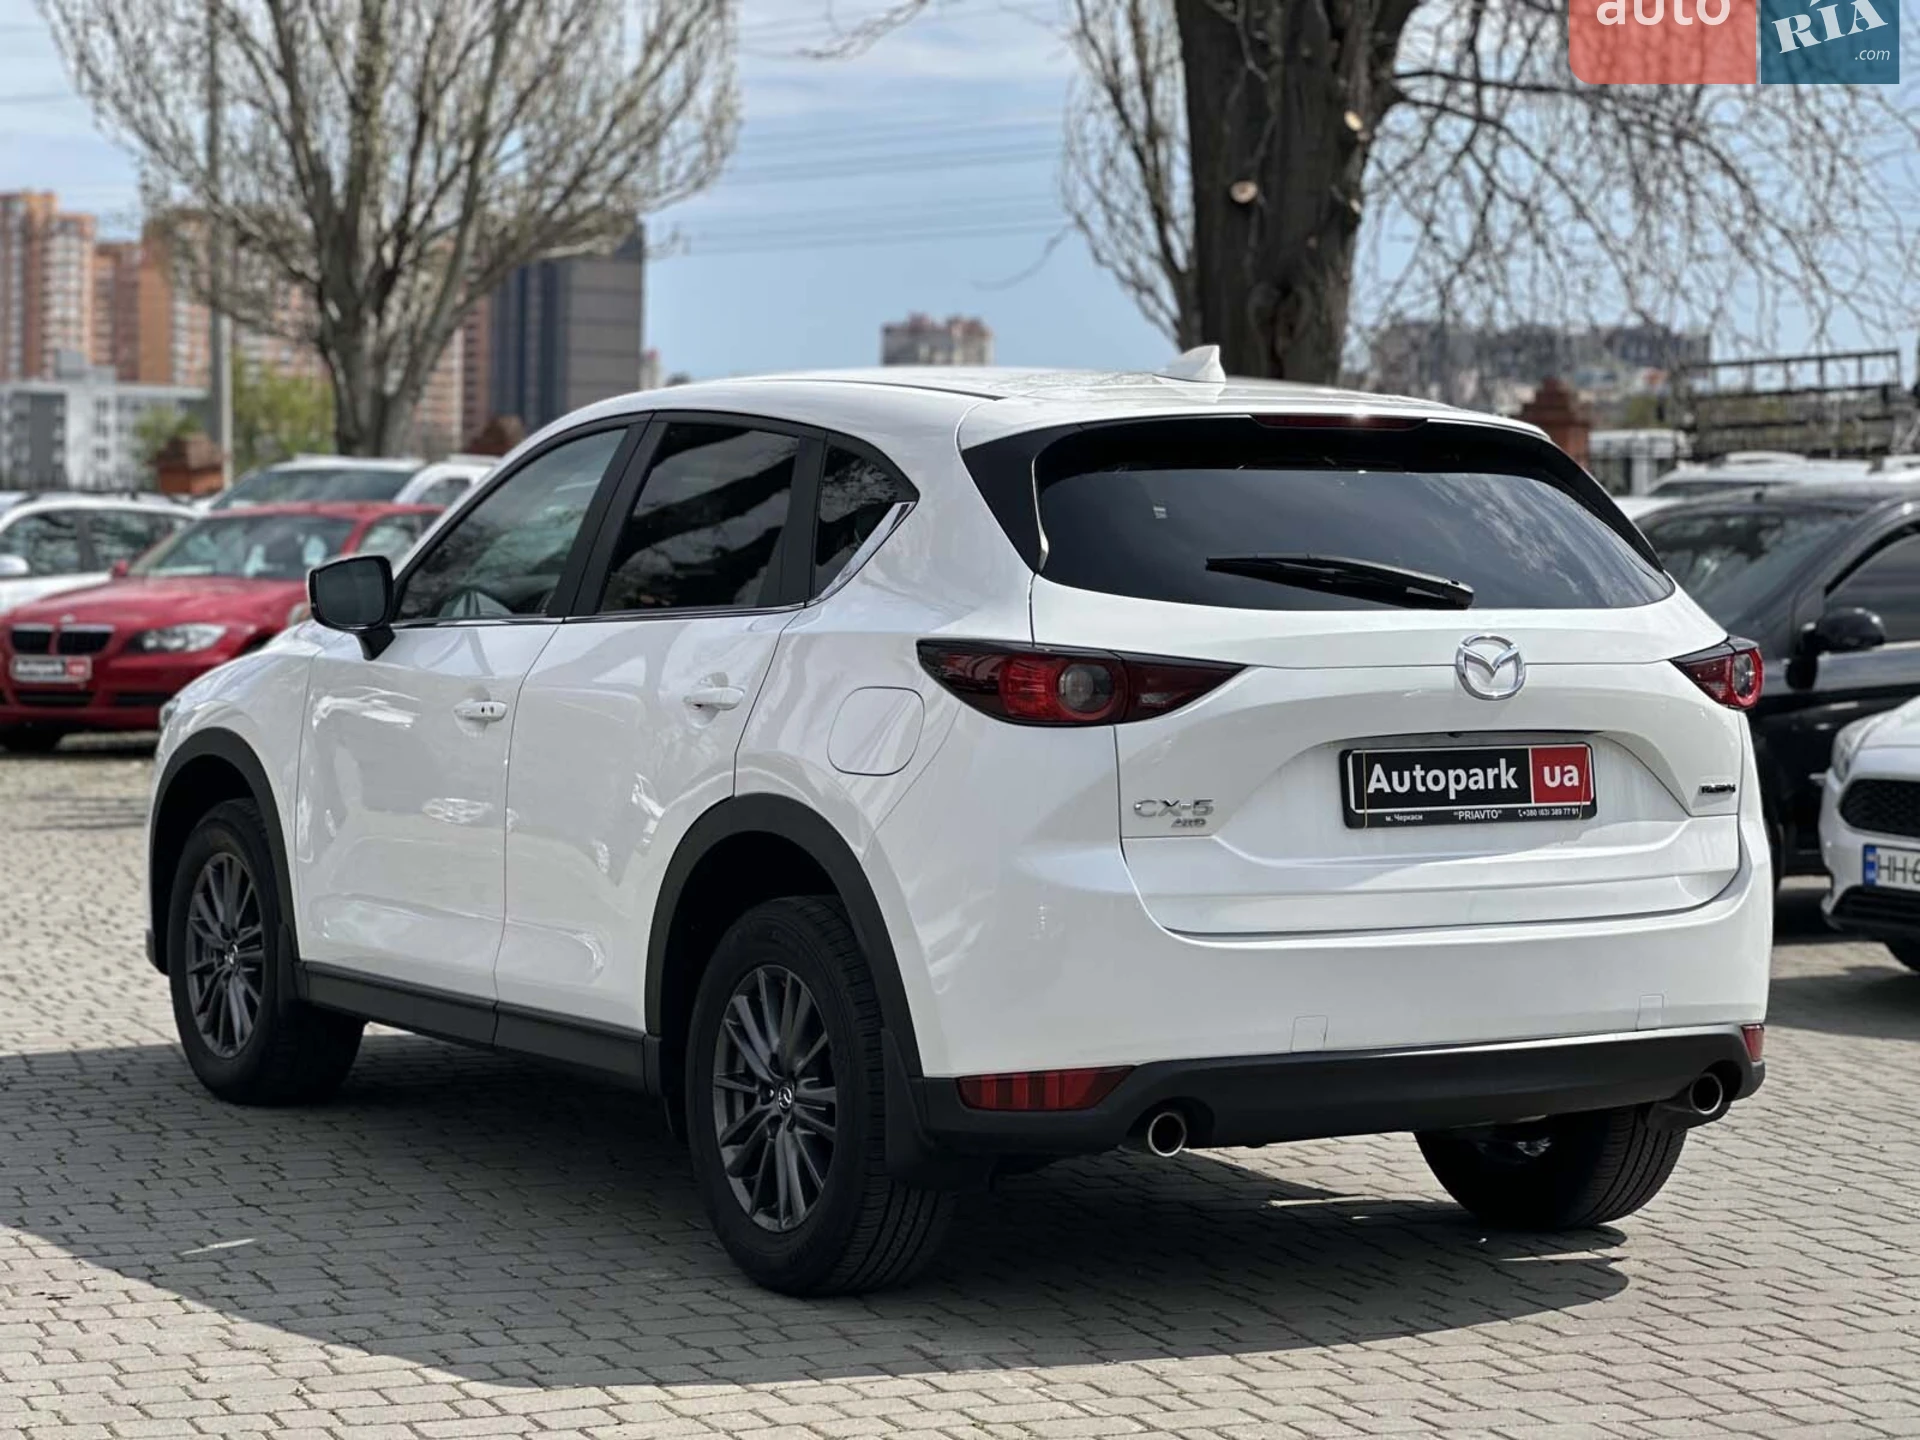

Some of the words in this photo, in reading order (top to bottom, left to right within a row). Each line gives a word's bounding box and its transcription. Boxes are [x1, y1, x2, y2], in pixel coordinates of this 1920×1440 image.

[1367, 758, 1518, 800] Autopark
[1543, 764, 1580, 788] ua
[1133, 799, 1215, 818] CX-5
